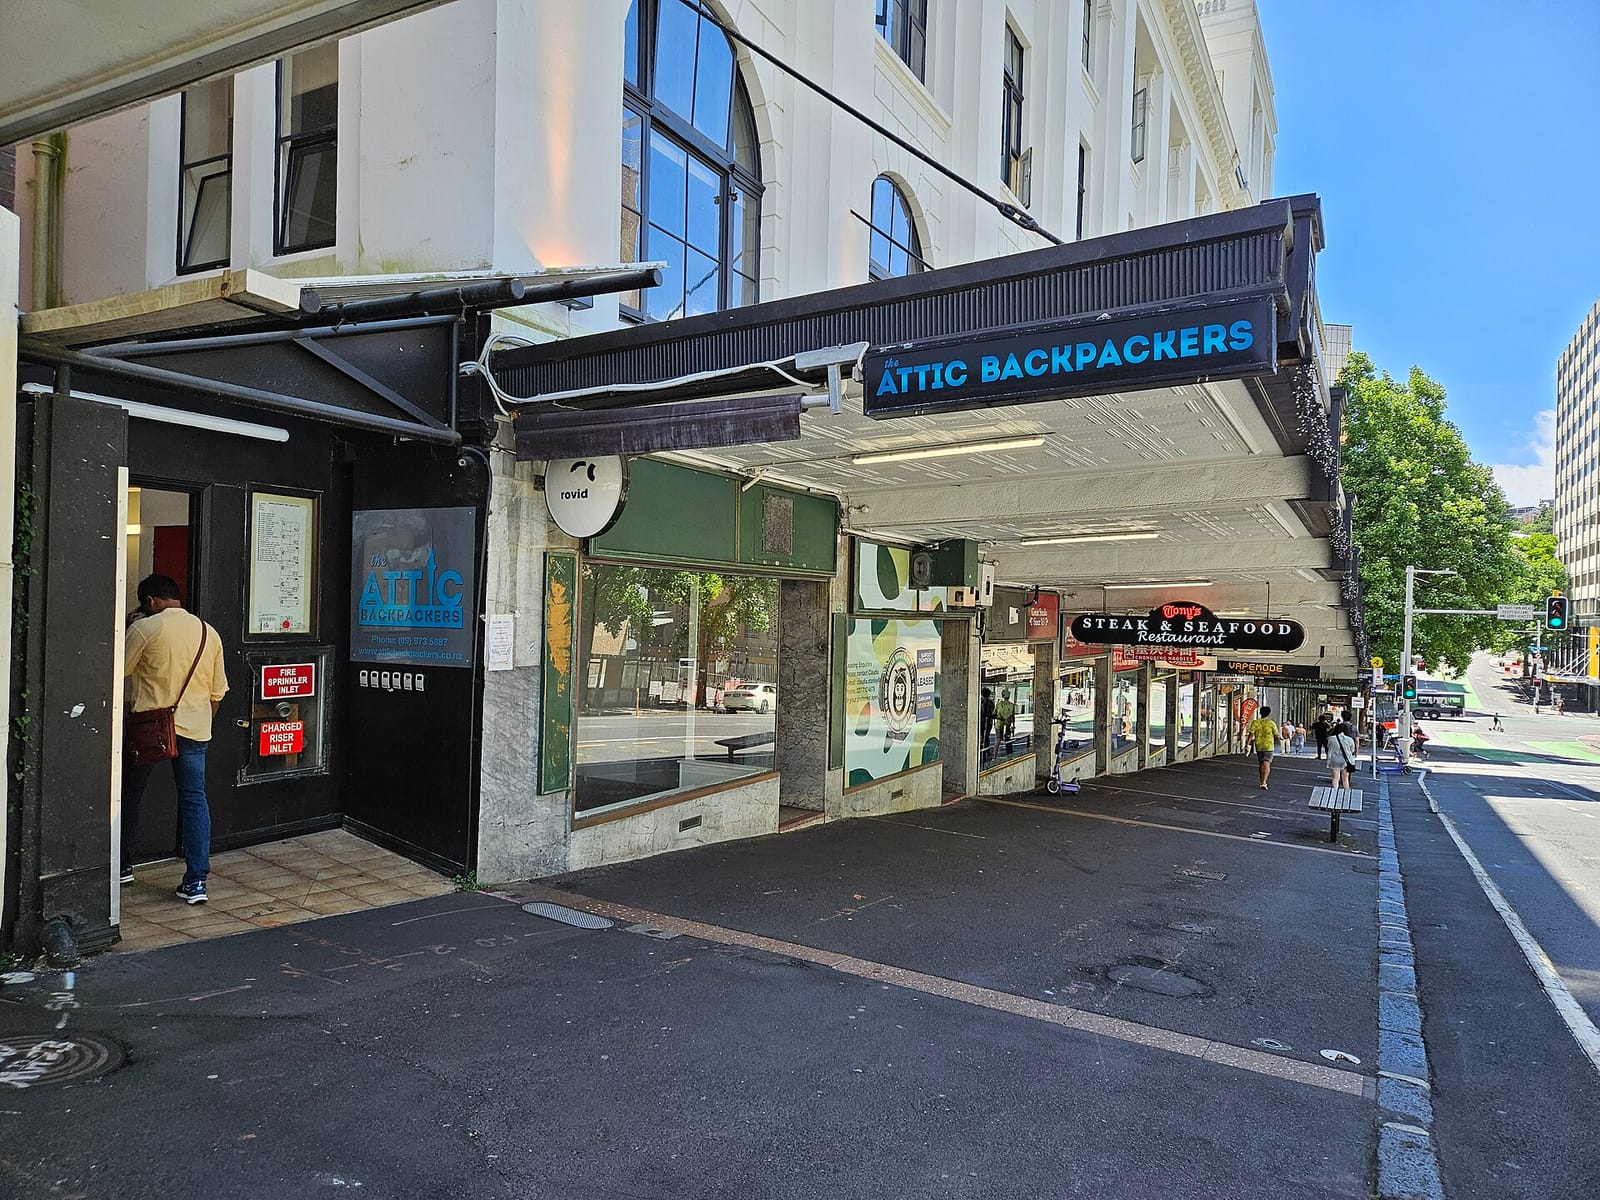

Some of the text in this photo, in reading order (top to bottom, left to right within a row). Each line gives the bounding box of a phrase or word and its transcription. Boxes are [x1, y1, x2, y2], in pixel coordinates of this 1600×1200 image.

[876, 320, 1254, 396] ATTIC BACKPACKERS
[884, 358, 899, 368] the
[560, 488, 588, 500] rovid
[359, 562, 464, 607] ATTIC
[360, 608, 460, 623] BACKPACKERS
[1162, 605, 1201, 620] Tony's
[1083, 618, 1291, 635] STEAK & SEAFOOD
[398, 636, 412, 647] (09)
[414, 637, 427, 646] 973
[1137, 630, 1227, 644] Restaurant
[280, 668, 296, 677] FIRE
[1228, 662, 1283, 673] VAPEMODE
[267, 676, 307, 687] SPRINKLER
[278, 686, 299, 695] INLET
[262, 722, 302, 734] CHARGED
[269, 732, 294, 744] RISER
[269, 743, 293, 754] INLET
